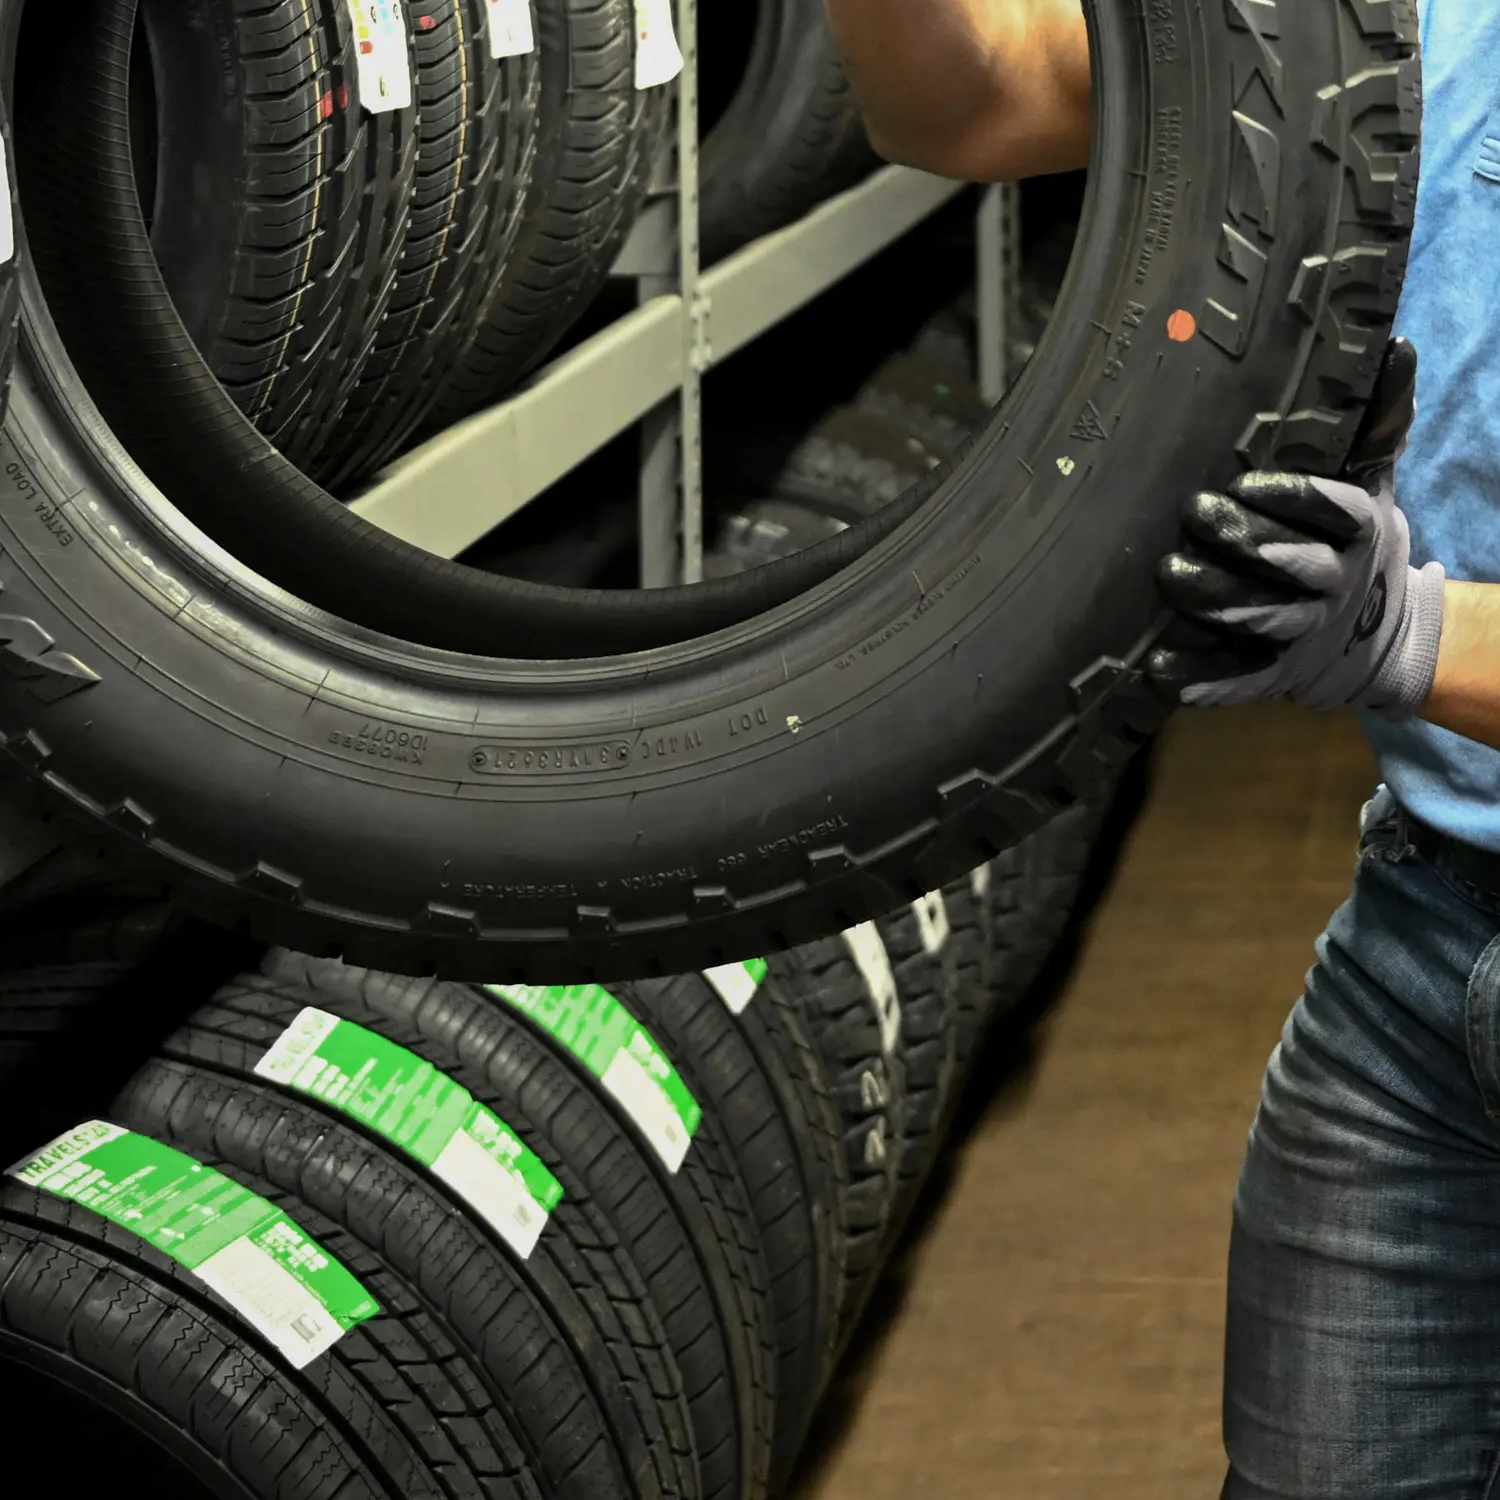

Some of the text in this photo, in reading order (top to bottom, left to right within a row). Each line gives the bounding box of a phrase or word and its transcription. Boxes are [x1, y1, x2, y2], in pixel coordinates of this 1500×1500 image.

[1, 460, 76, 549] EXTRA LOAD
[727, 706, 767, 736] DOT
[620, 865, 698, 890] TRACTION
